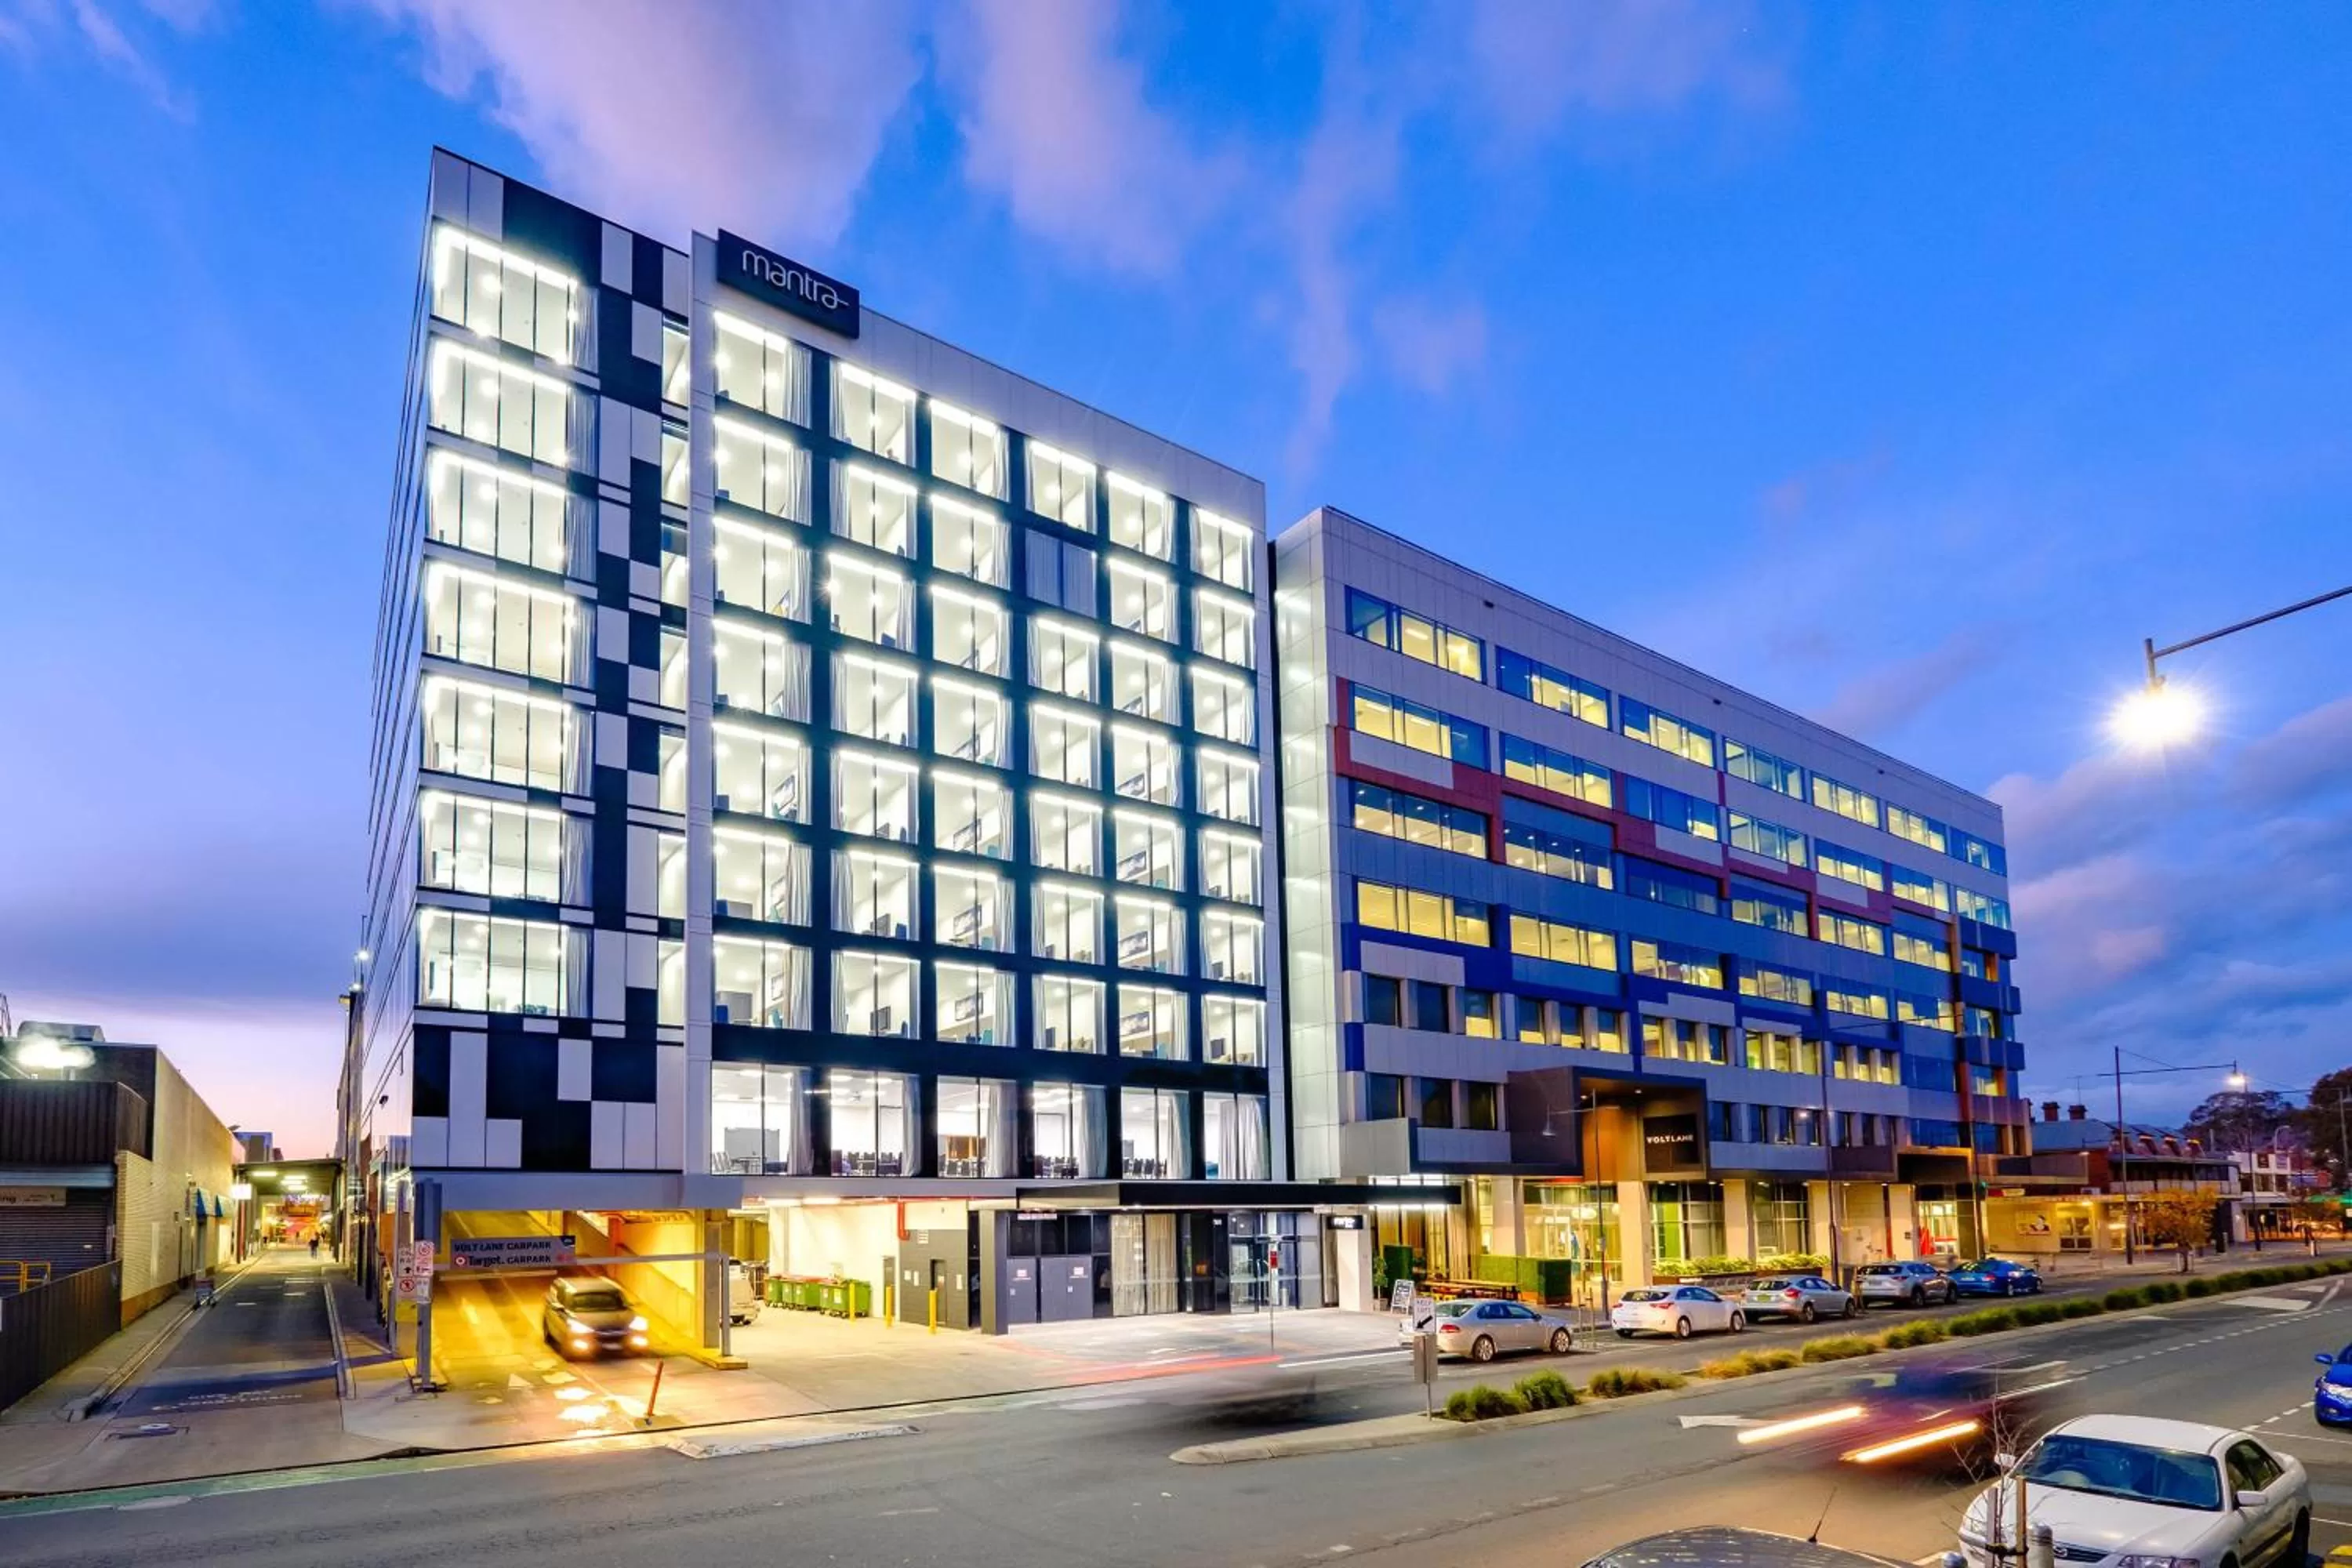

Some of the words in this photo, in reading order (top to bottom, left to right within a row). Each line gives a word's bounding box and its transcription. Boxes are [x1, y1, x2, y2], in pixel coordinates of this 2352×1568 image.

[742, 250, 850, 310] mantra
[506, 1241, 552, 1250] CARPARK
[506, 1254, 551, 1265] CARPARK
